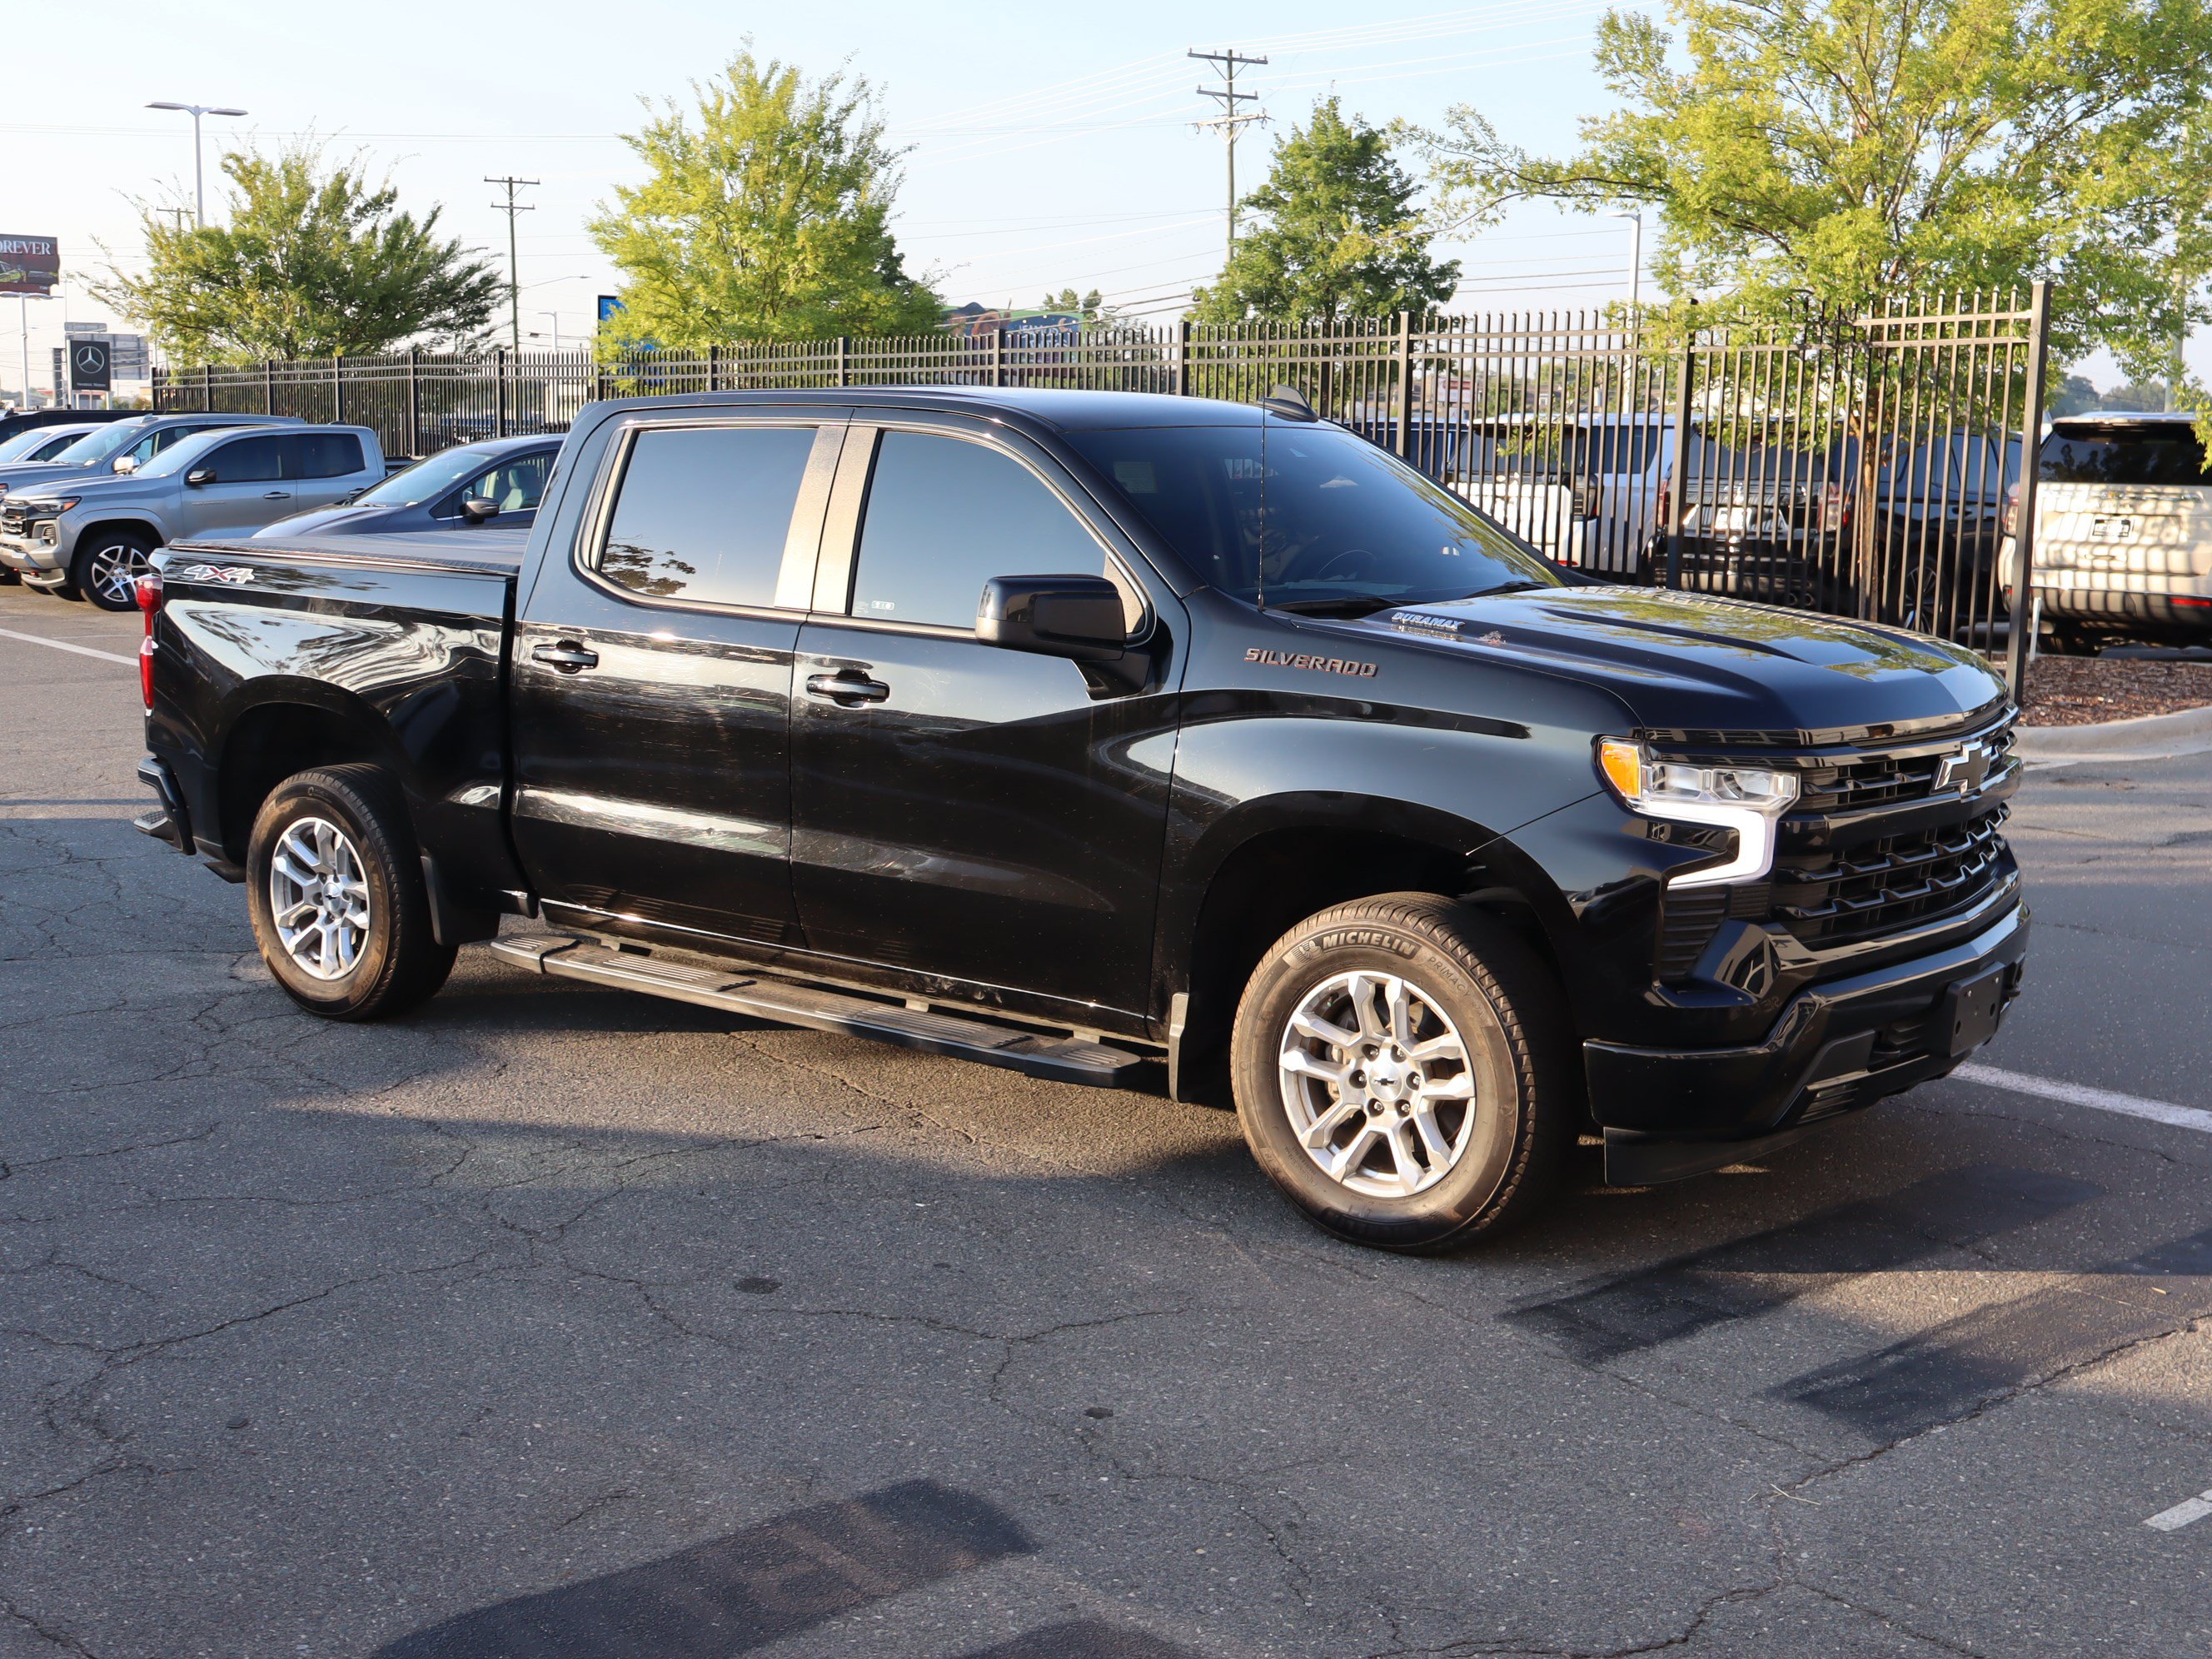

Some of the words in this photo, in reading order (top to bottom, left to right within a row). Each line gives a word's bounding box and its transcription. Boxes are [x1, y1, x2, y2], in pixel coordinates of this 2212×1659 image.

[0, 240, 51, 255] REVER
[1392, 612, 1466, 631] DURAMAX
[1243, 648, 1379, 678] SILVERADO
[1323, 931, 1416, 955] MICHELIN
[1427, 956, 1471, 998] PRIMACY
